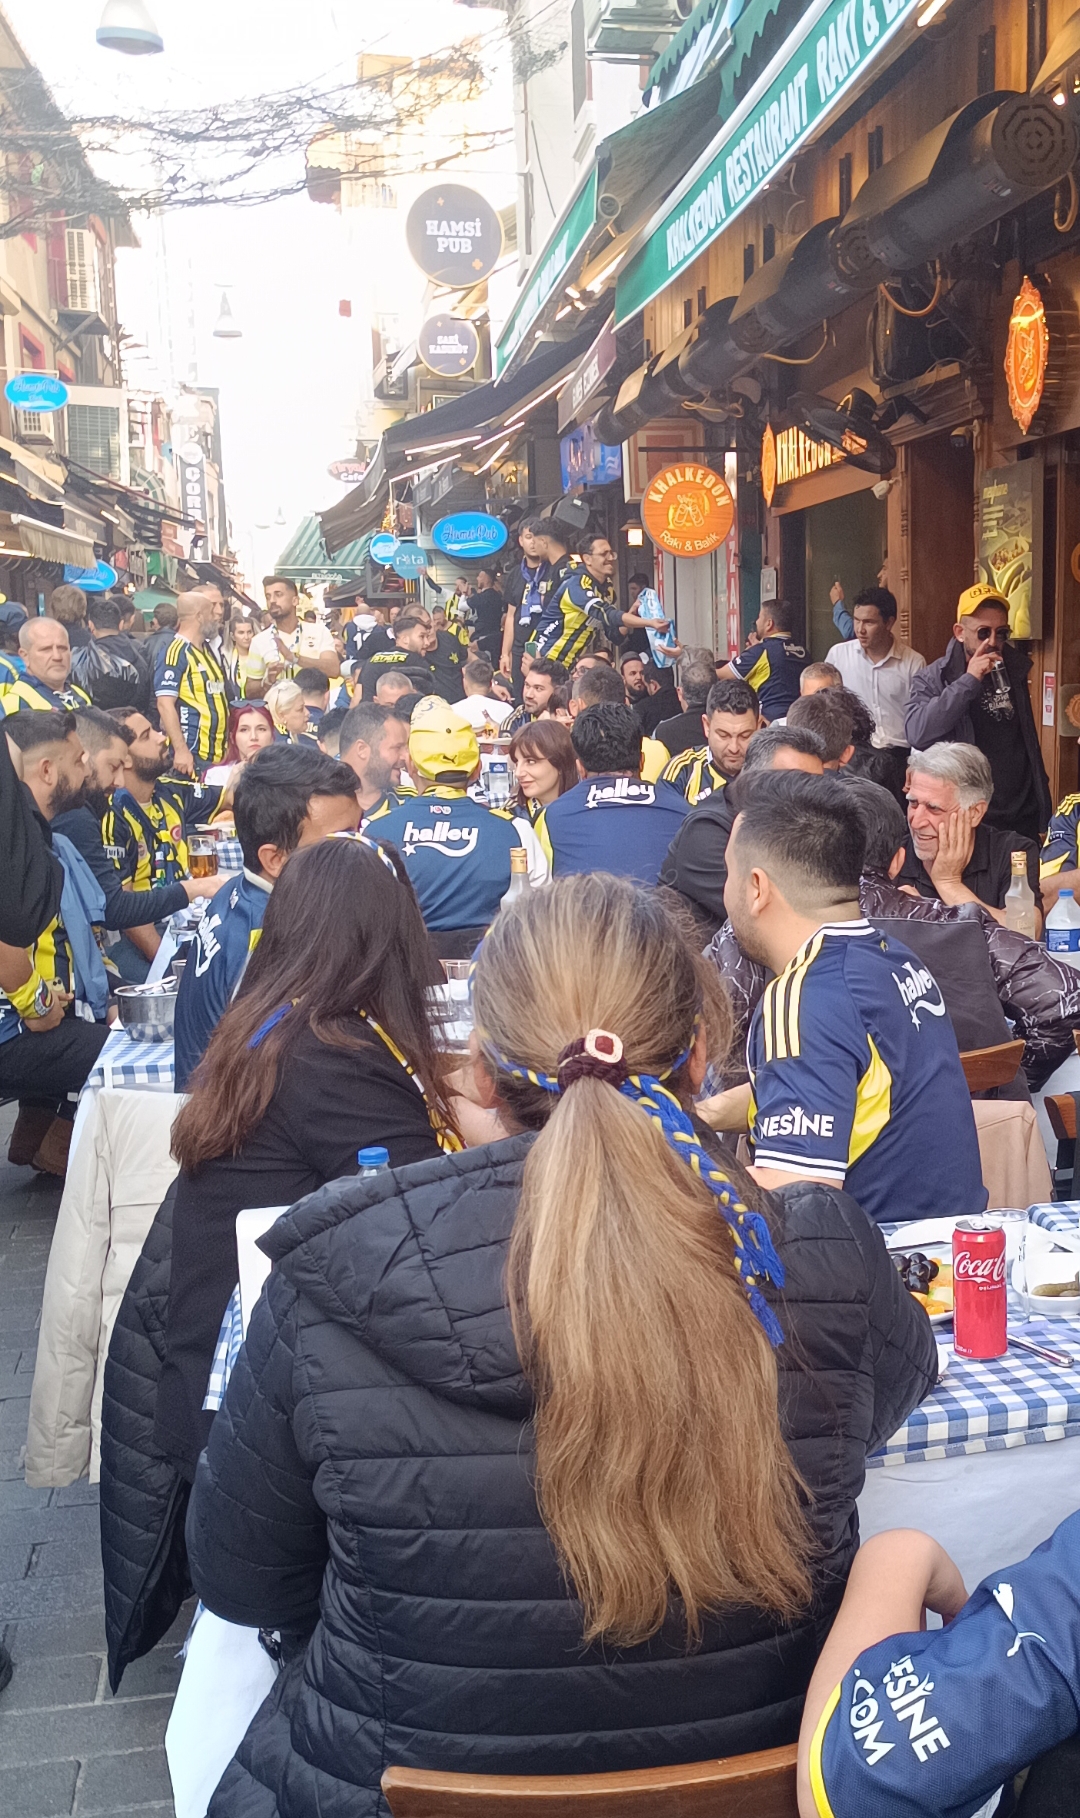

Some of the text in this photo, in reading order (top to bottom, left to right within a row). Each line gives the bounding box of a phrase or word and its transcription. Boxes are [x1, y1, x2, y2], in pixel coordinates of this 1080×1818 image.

[666, 170, 727, 271] KHALKEDON
[725, 63, 808, 208] RESTAURANT
[816, 0, 860, 104] RAKI
[425, 217, 482, 237] HAMSİ
[437, 238, 473, 253] PUB
[648, 467, 731, 507] KHALKEDON
[684, 541, 693, 551] &
[586, 777, 656, 805] halley
[402, 821, 479, 857] halley
